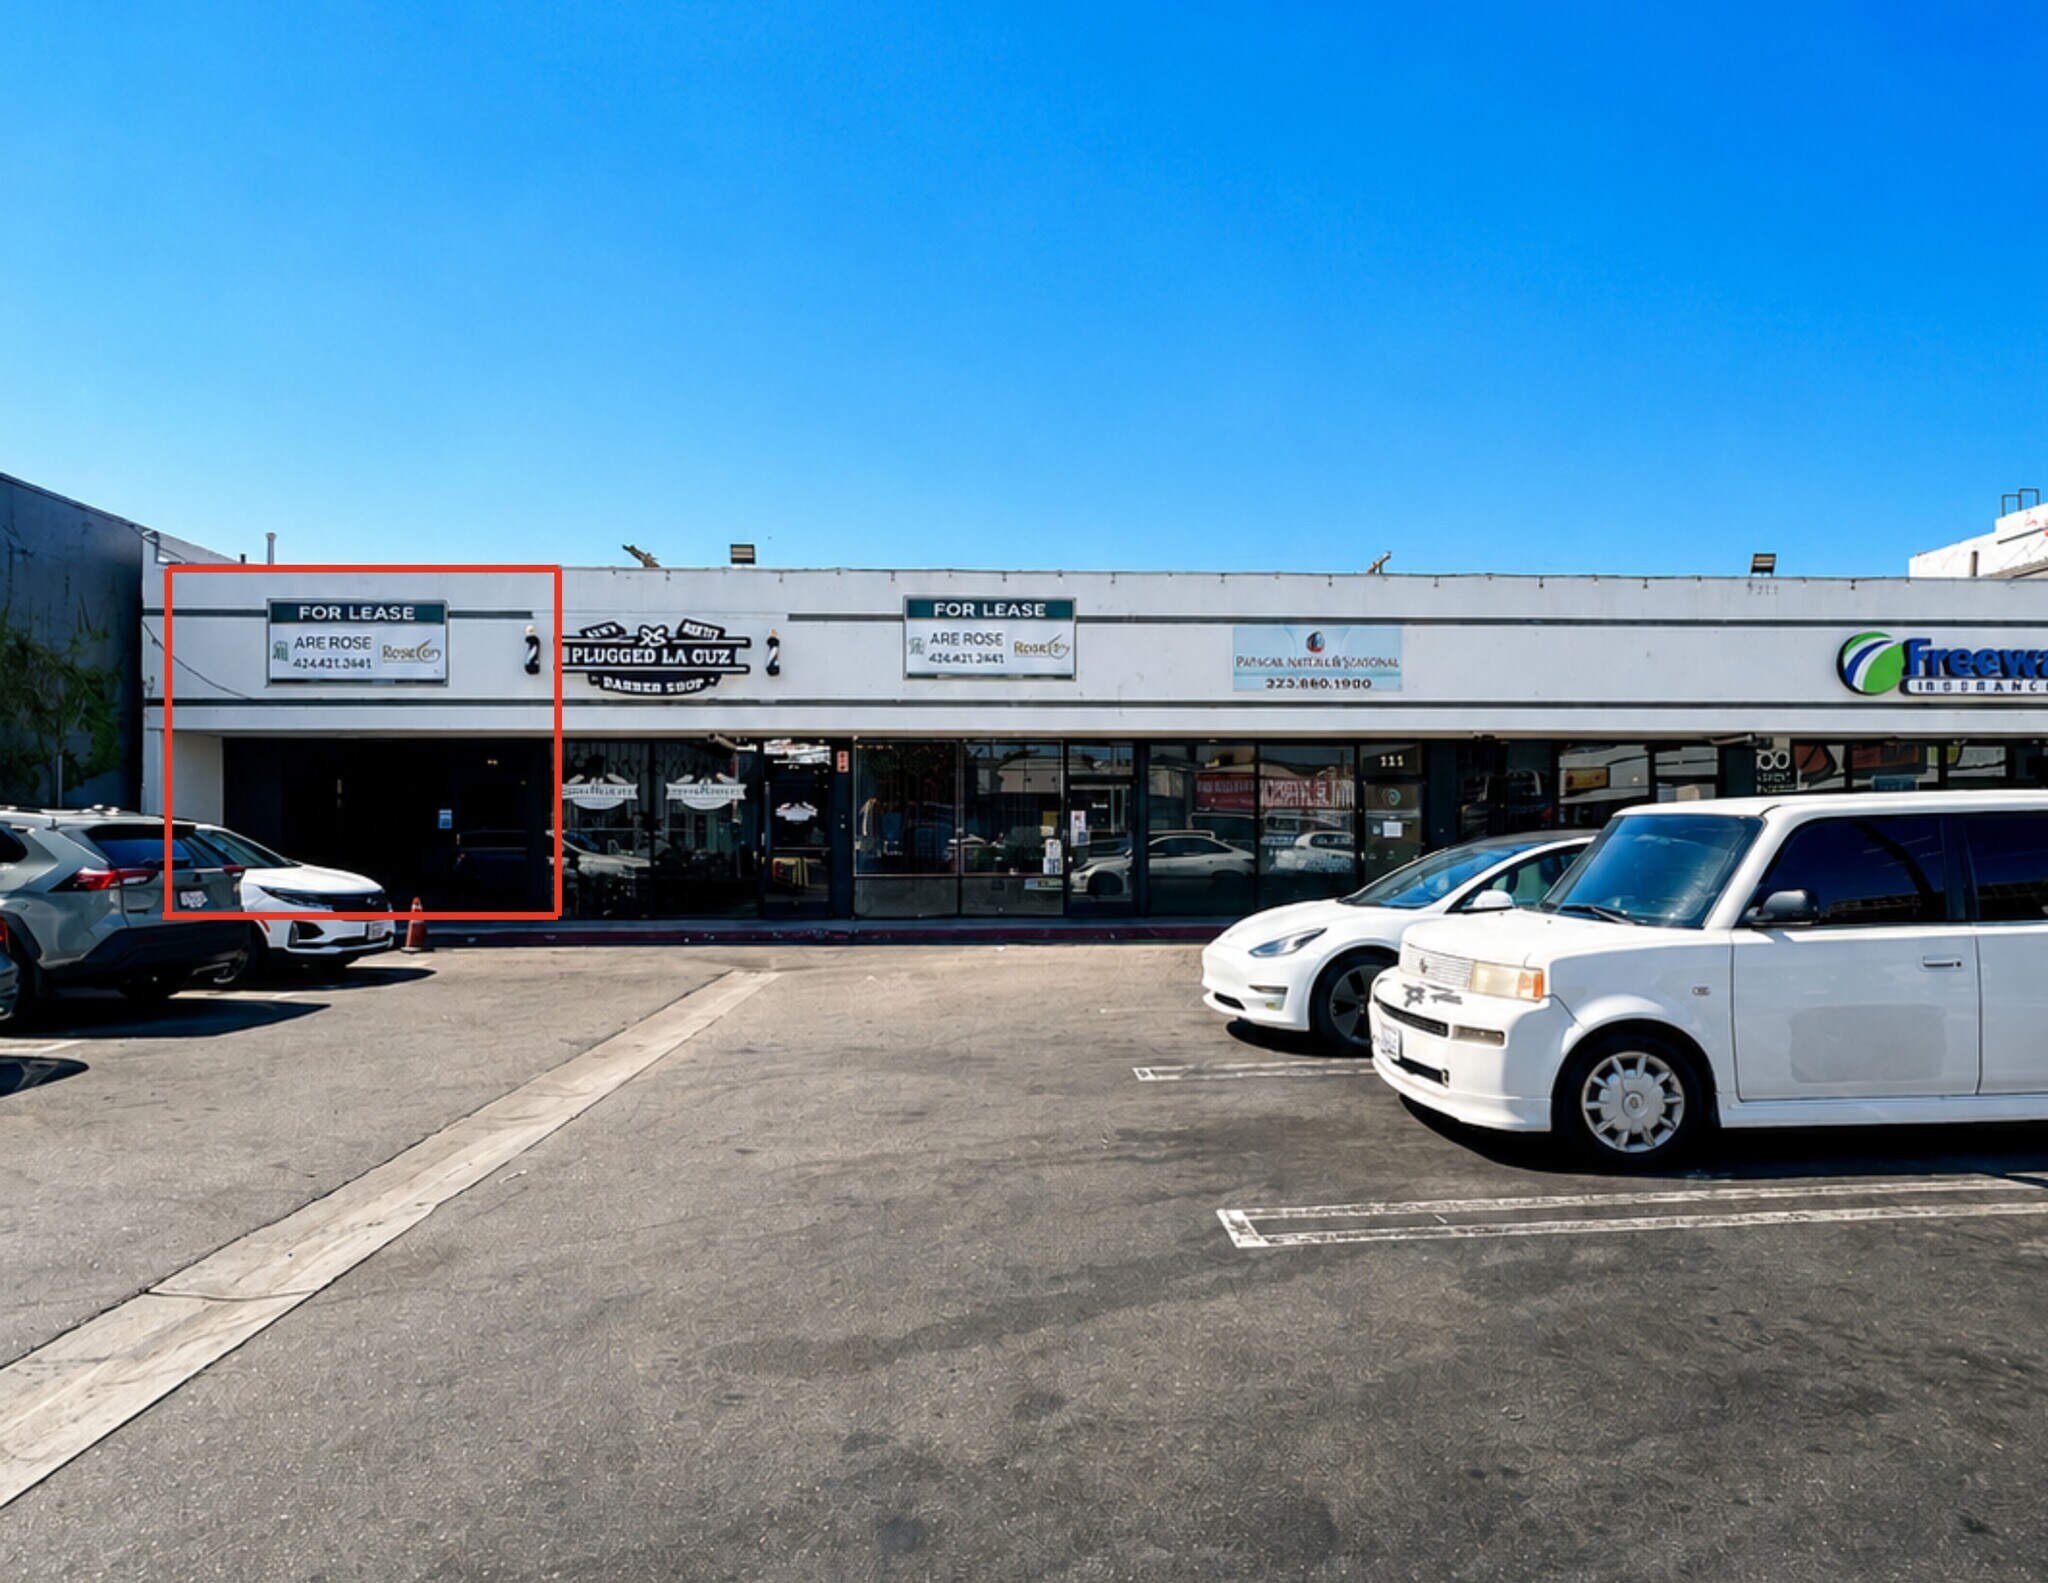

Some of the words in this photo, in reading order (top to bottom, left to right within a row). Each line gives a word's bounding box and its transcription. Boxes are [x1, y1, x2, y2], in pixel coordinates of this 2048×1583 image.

[298, 605, 341, 621] FOR
[348, 605, 416, 621] LEASE
[934, 602, 976, 618] FOR
[982, 602, 1047, 618] LEASE
[294, 635, 326, 650] ARE
[329, 635, 372, 650] ROSE
[929, 631, 960, 646] ARE
[963, 631, 1004, 647] ROSE
[571, 646, 657, 665] PLUGGED
[661, 646, 688, 665] LA
[603, 675, 662, 693] BARBER
[666, 677, 705, 693] SHOP
[1918, 681, 2048, 692] INSURANC
